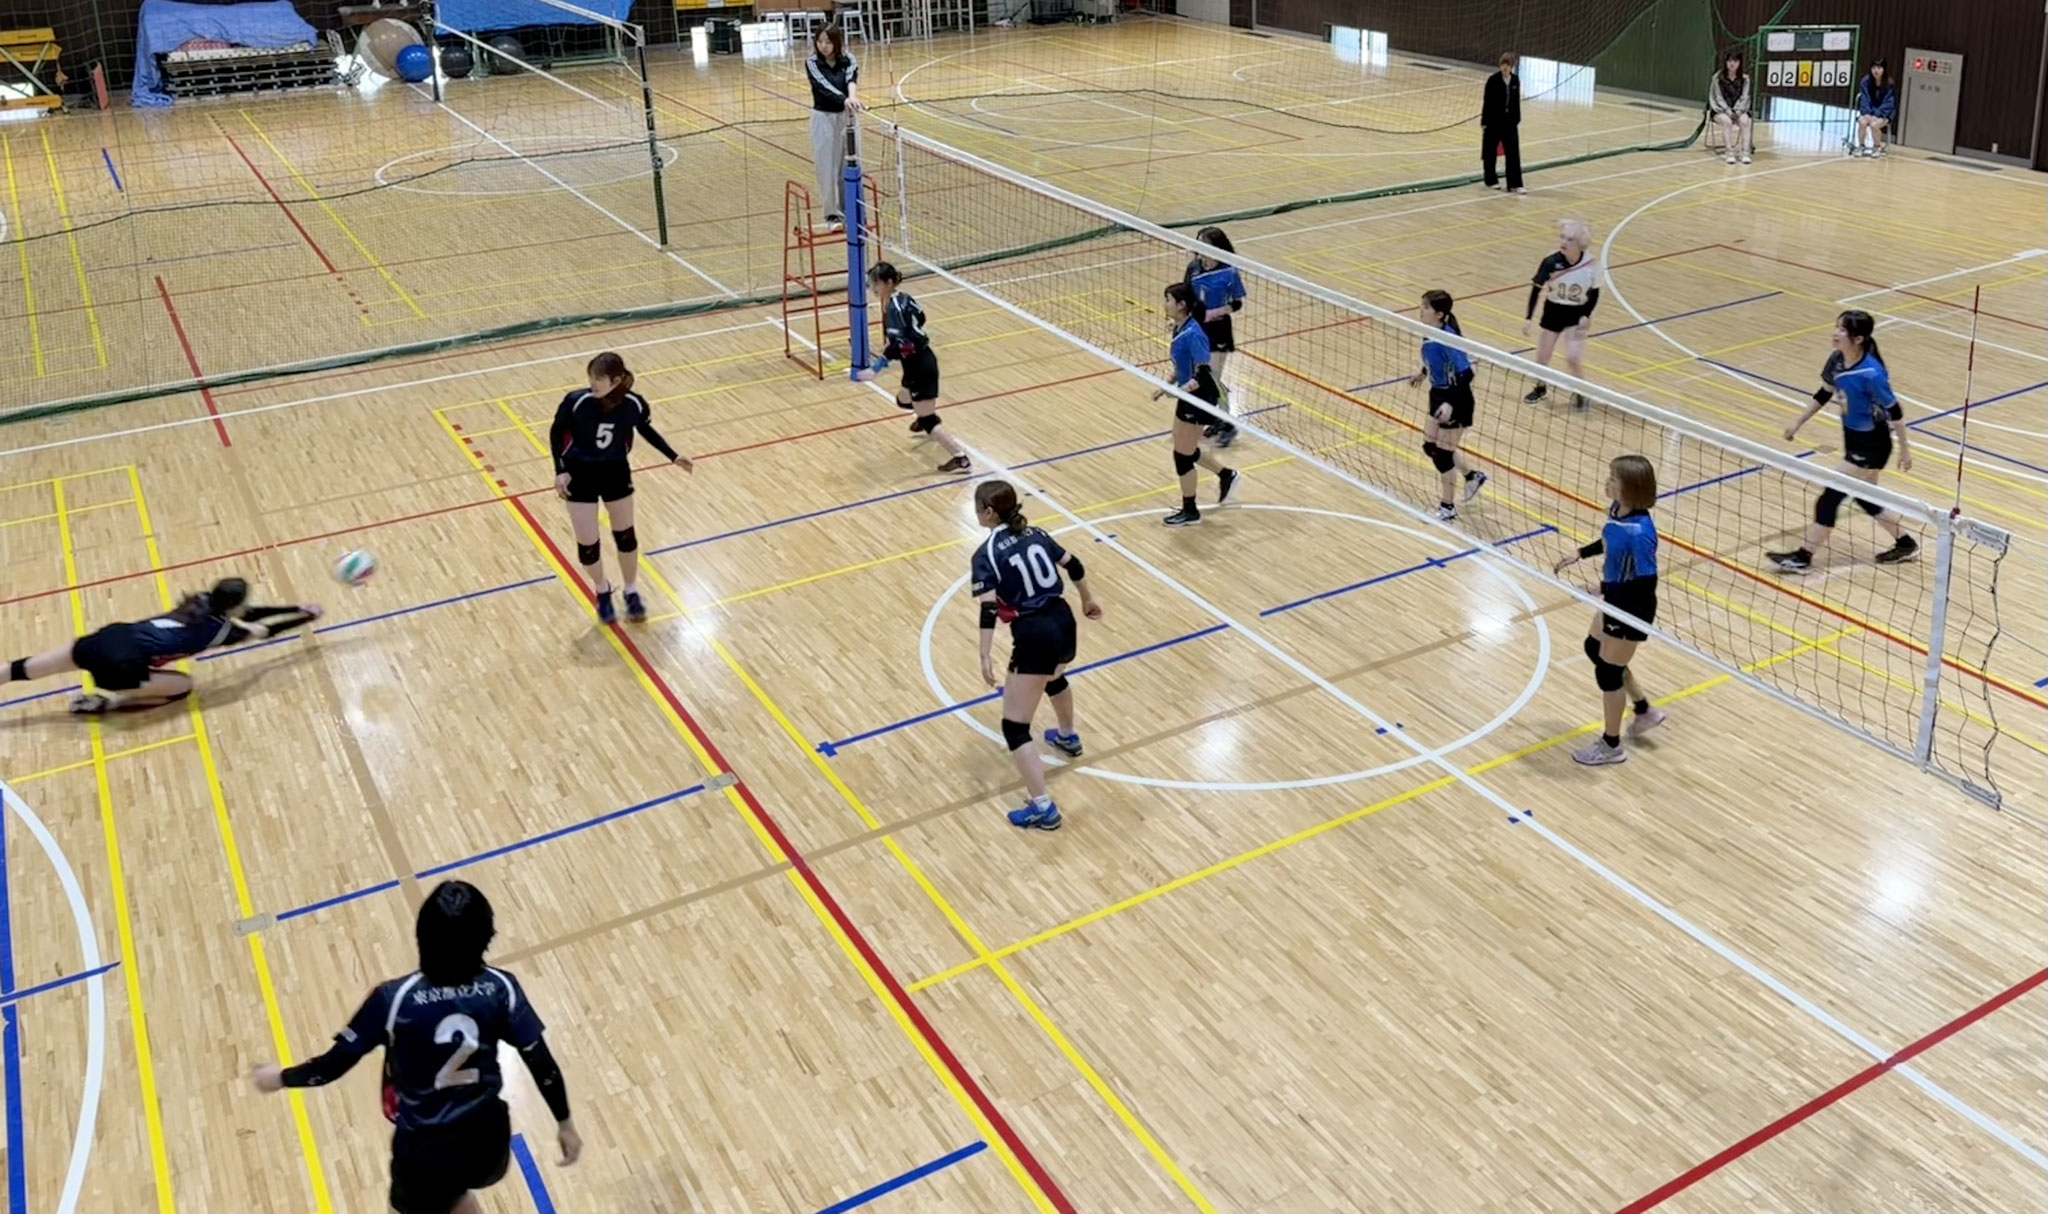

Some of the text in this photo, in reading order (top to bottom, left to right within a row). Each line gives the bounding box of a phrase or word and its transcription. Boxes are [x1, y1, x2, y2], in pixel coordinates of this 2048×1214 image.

[1557, 282, 1582, 302] 12
[595, 423, 615, 449] 5
[1008, 543, 1058, 598] 10
[433, 1013, 479, 1090] 2
